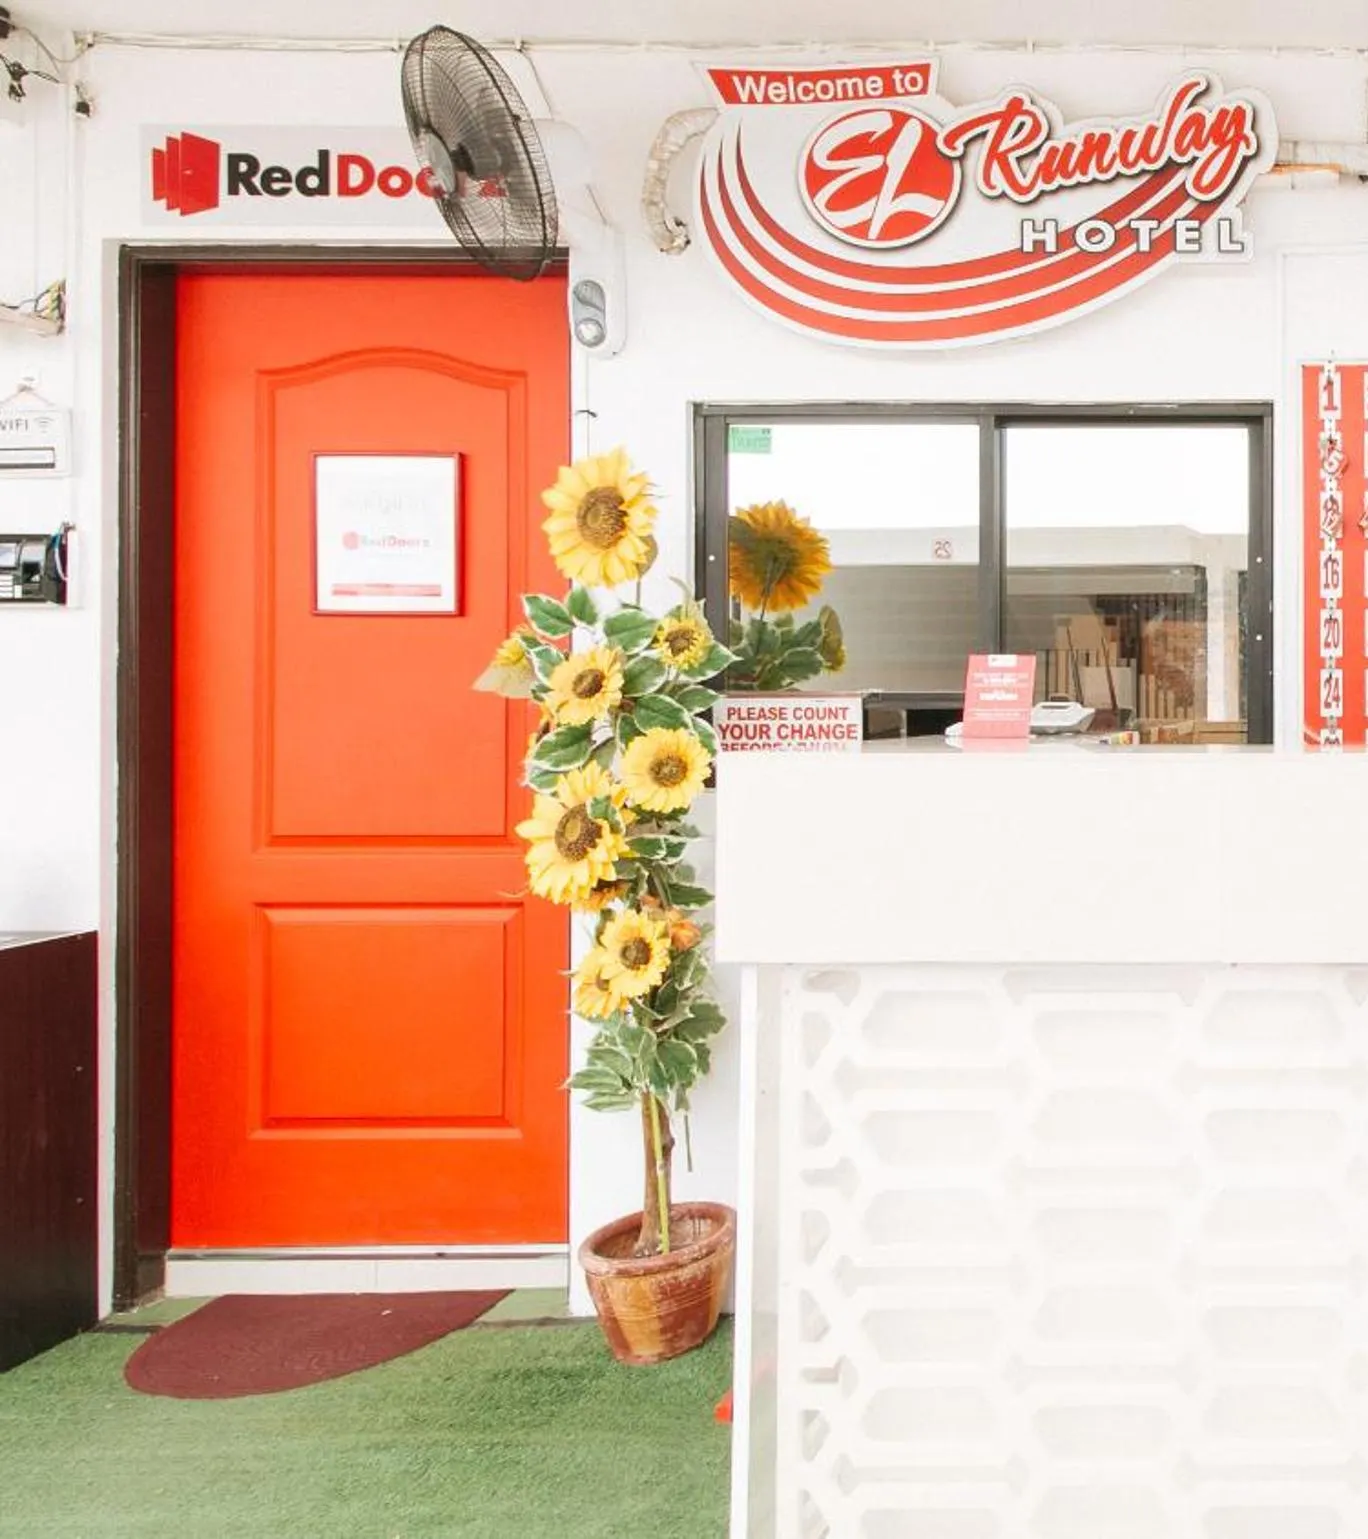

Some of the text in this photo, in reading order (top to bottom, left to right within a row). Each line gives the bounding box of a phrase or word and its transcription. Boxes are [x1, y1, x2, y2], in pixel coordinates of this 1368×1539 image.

[732, 69, 924, 104] Welcome to
[812, 110, 946, 241] EL
[1021, 219, 1246, 254] HOTEL
[1323, 377, 1338, 412] 1
[1323, 556, 1340, 589] 16
[1323, 616, 1340, 649] 20
[1323, 676, 1340, 708] 24
[727, 707, 849, 721] PLEASE COUNT
[718, 723, 858, 741] YOUR CHANGE
